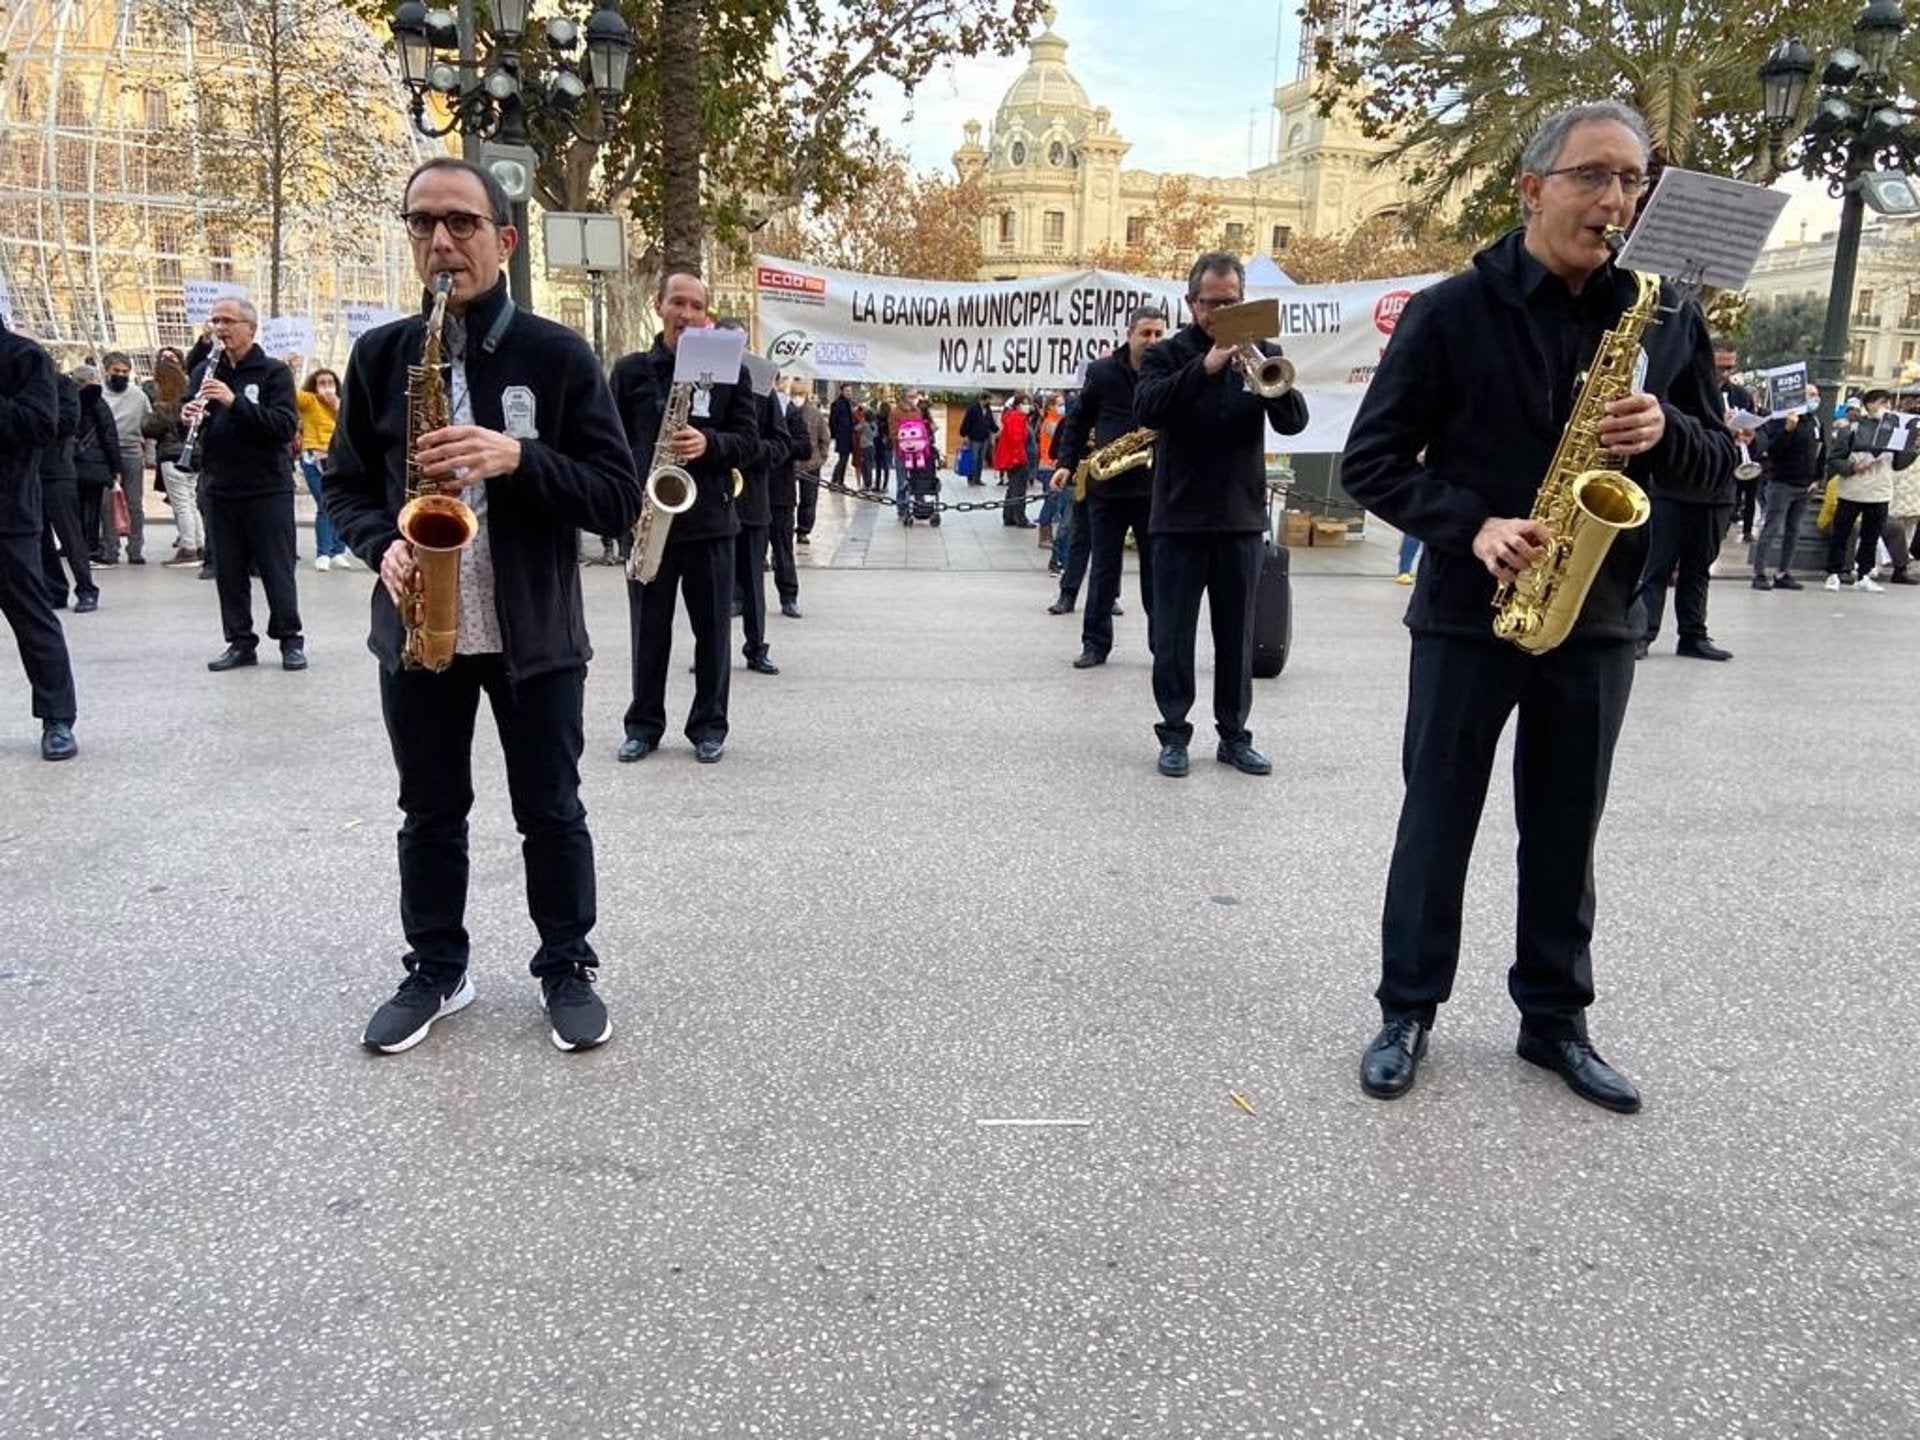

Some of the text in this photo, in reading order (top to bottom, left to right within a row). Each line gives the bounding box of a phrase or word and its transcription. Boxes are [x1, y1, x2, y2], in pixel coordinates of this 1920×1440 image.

[760, 271, 804, 287] CCOO
[852, 289, 877, 324] LA
[882, 294, 952, 327] BANDA
[957, 289, 1064, 327] MUNICIPAL
[1159, 295, 1171, 329] A
[1280, 302, 1340, 334] MENT!!
[938, 337, 969, 374] NO
[972, 338, 996, 374] AL
[1002, 337, 1042, 374] SEU
